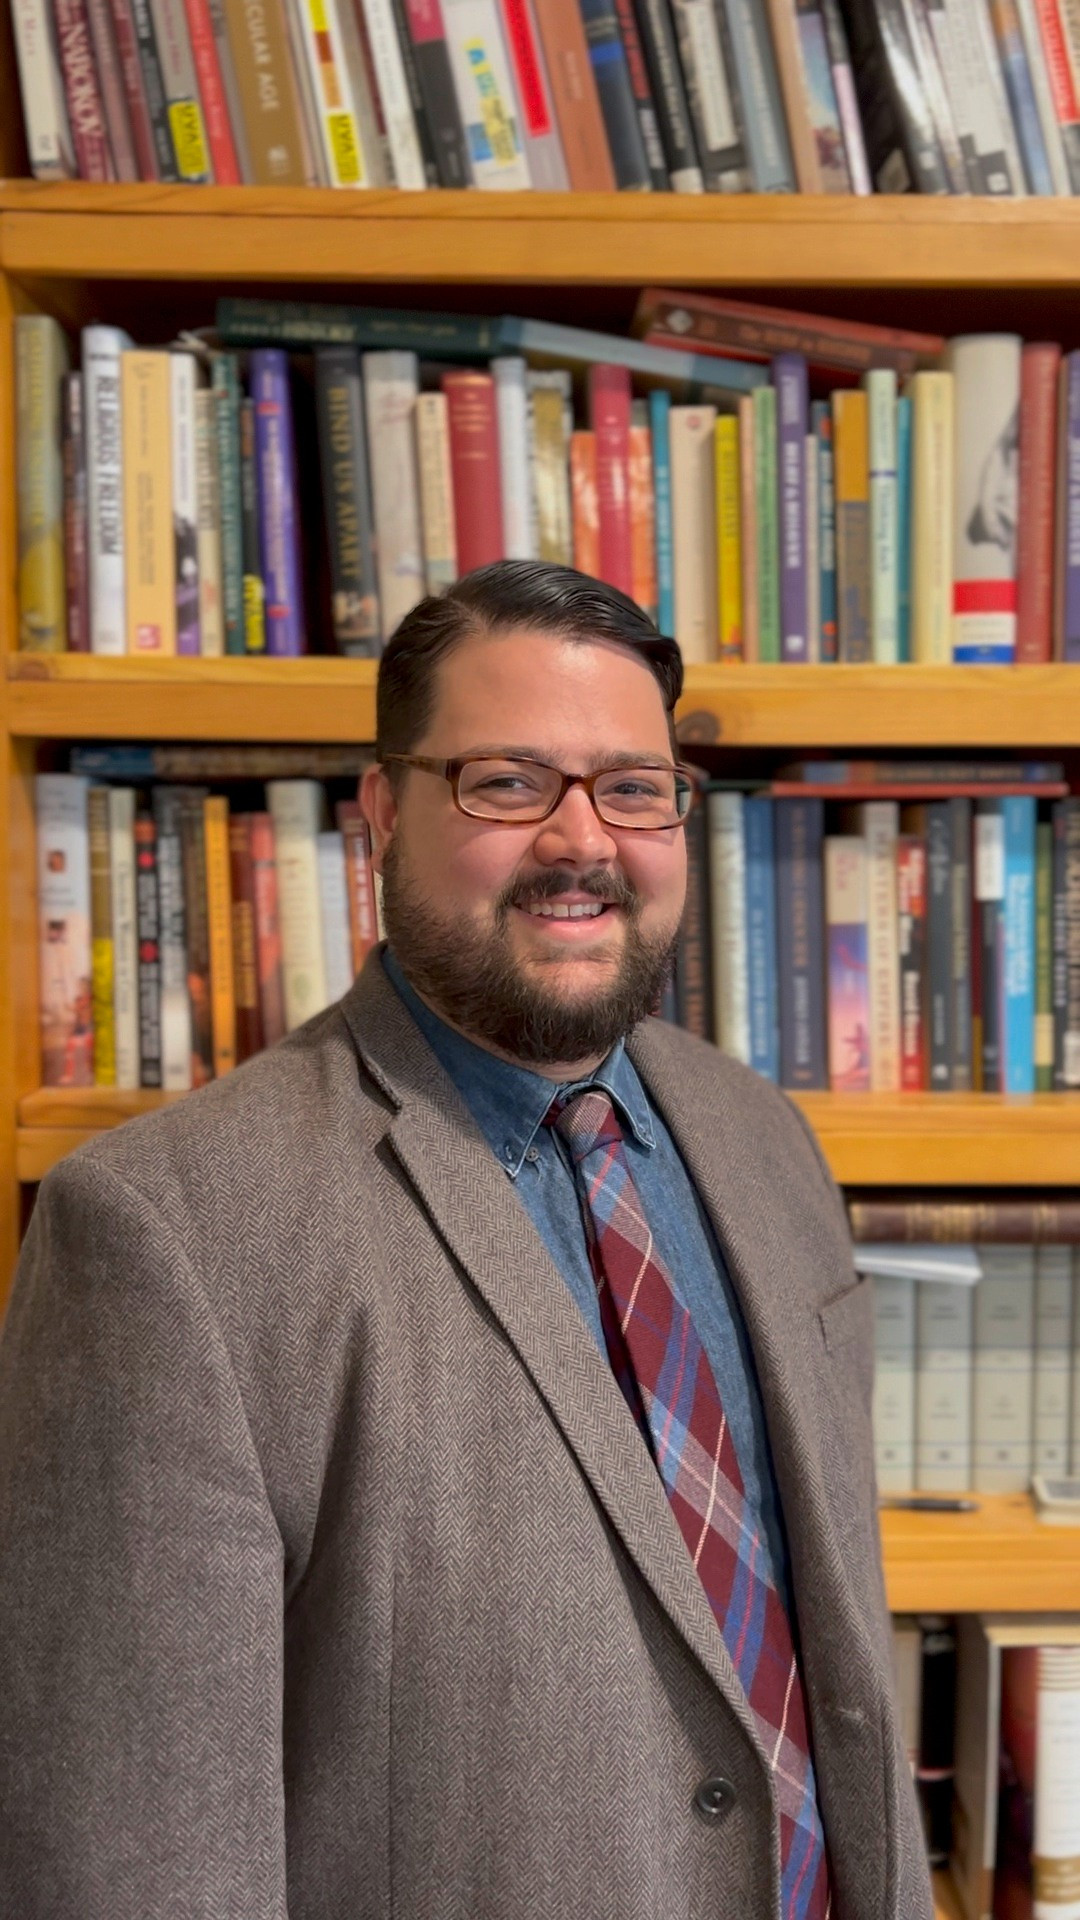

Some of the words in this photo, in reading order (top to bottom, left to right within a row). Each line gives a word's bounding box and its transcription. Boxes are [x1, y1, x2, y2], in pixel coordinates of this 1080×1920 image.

[245, 0, 272, 65] CULAR
[58, 21, 106, 139] NABOKOV
[255, 70, 281, 111] AGE
[181, 103, 203, 143] UVA
[335, 113, 357, 154] UVA
[97, 375, 121, 465] RELIGIOUS
[328, 386, 353, 453] BIND
[334, 460, 357, 496] US
[98, 473, 122, 555] FREEDOM
[336, 499, 361, 580] APART
[875, 831, 889, 931] MASTERS
[876, 936, 889, 960] OF
[876, 967, 889, 1047] EMPIRE
[904, 970, 920, 1011] David
